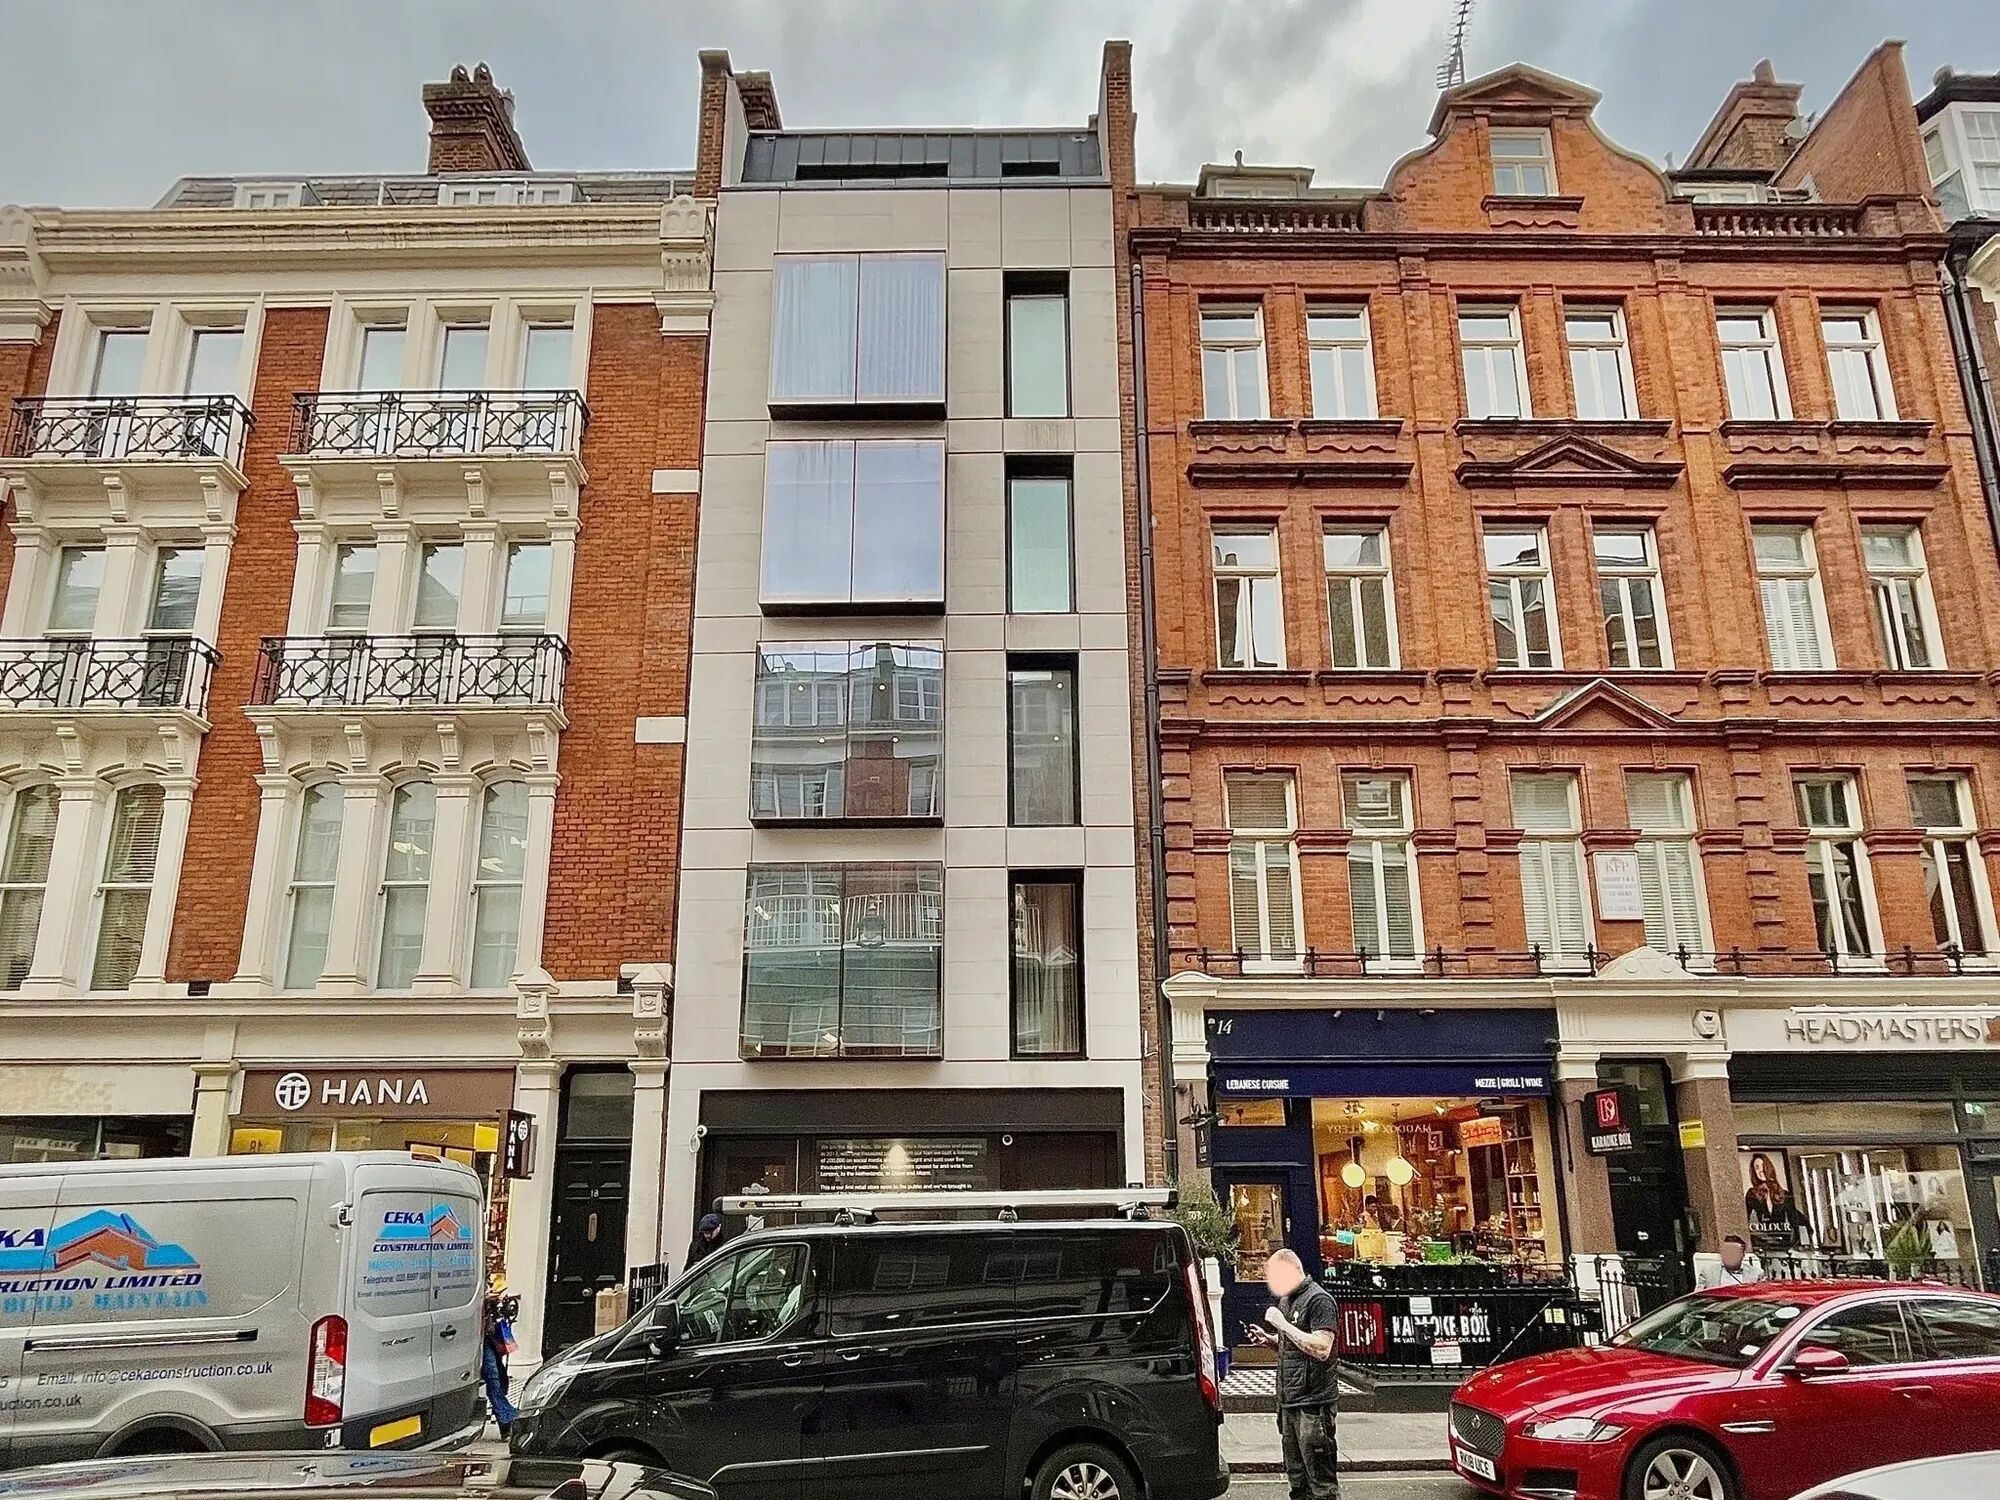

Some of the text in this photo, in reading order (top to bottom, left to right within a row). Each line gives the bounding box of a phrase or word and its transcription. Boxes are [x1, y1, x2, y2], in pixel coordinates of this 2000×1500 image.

[1216, 1019, 1233, 1035] 14
[1784, 1016, 1981, 1043] HEADMASTERS
[1226, 1079, 1290, 1090] LEBANESE CUISINE
[1475, 1078, 1543, 1089] MEZZE GRILL WINE
[321, 1079, 429, 1105] HANA
[507, 1119, 517, 1170] HANA
[1591, 1132, 1632, 1148] KARAOKE BOX
[590, 1189, 600, 1198] 18
[384, 1211, 425, 1224] CEKA
[1749, 1222, 1792, 1231] COLOUR
[372, 1242, 445, 1253] CONSTRUCTION
[105, 1273, 202, 1290] LIMITED
[1460, 1315, 1490, 1337] BOX
[81, 1361, 273, 1385] info@cekaconstruction.co.uk
